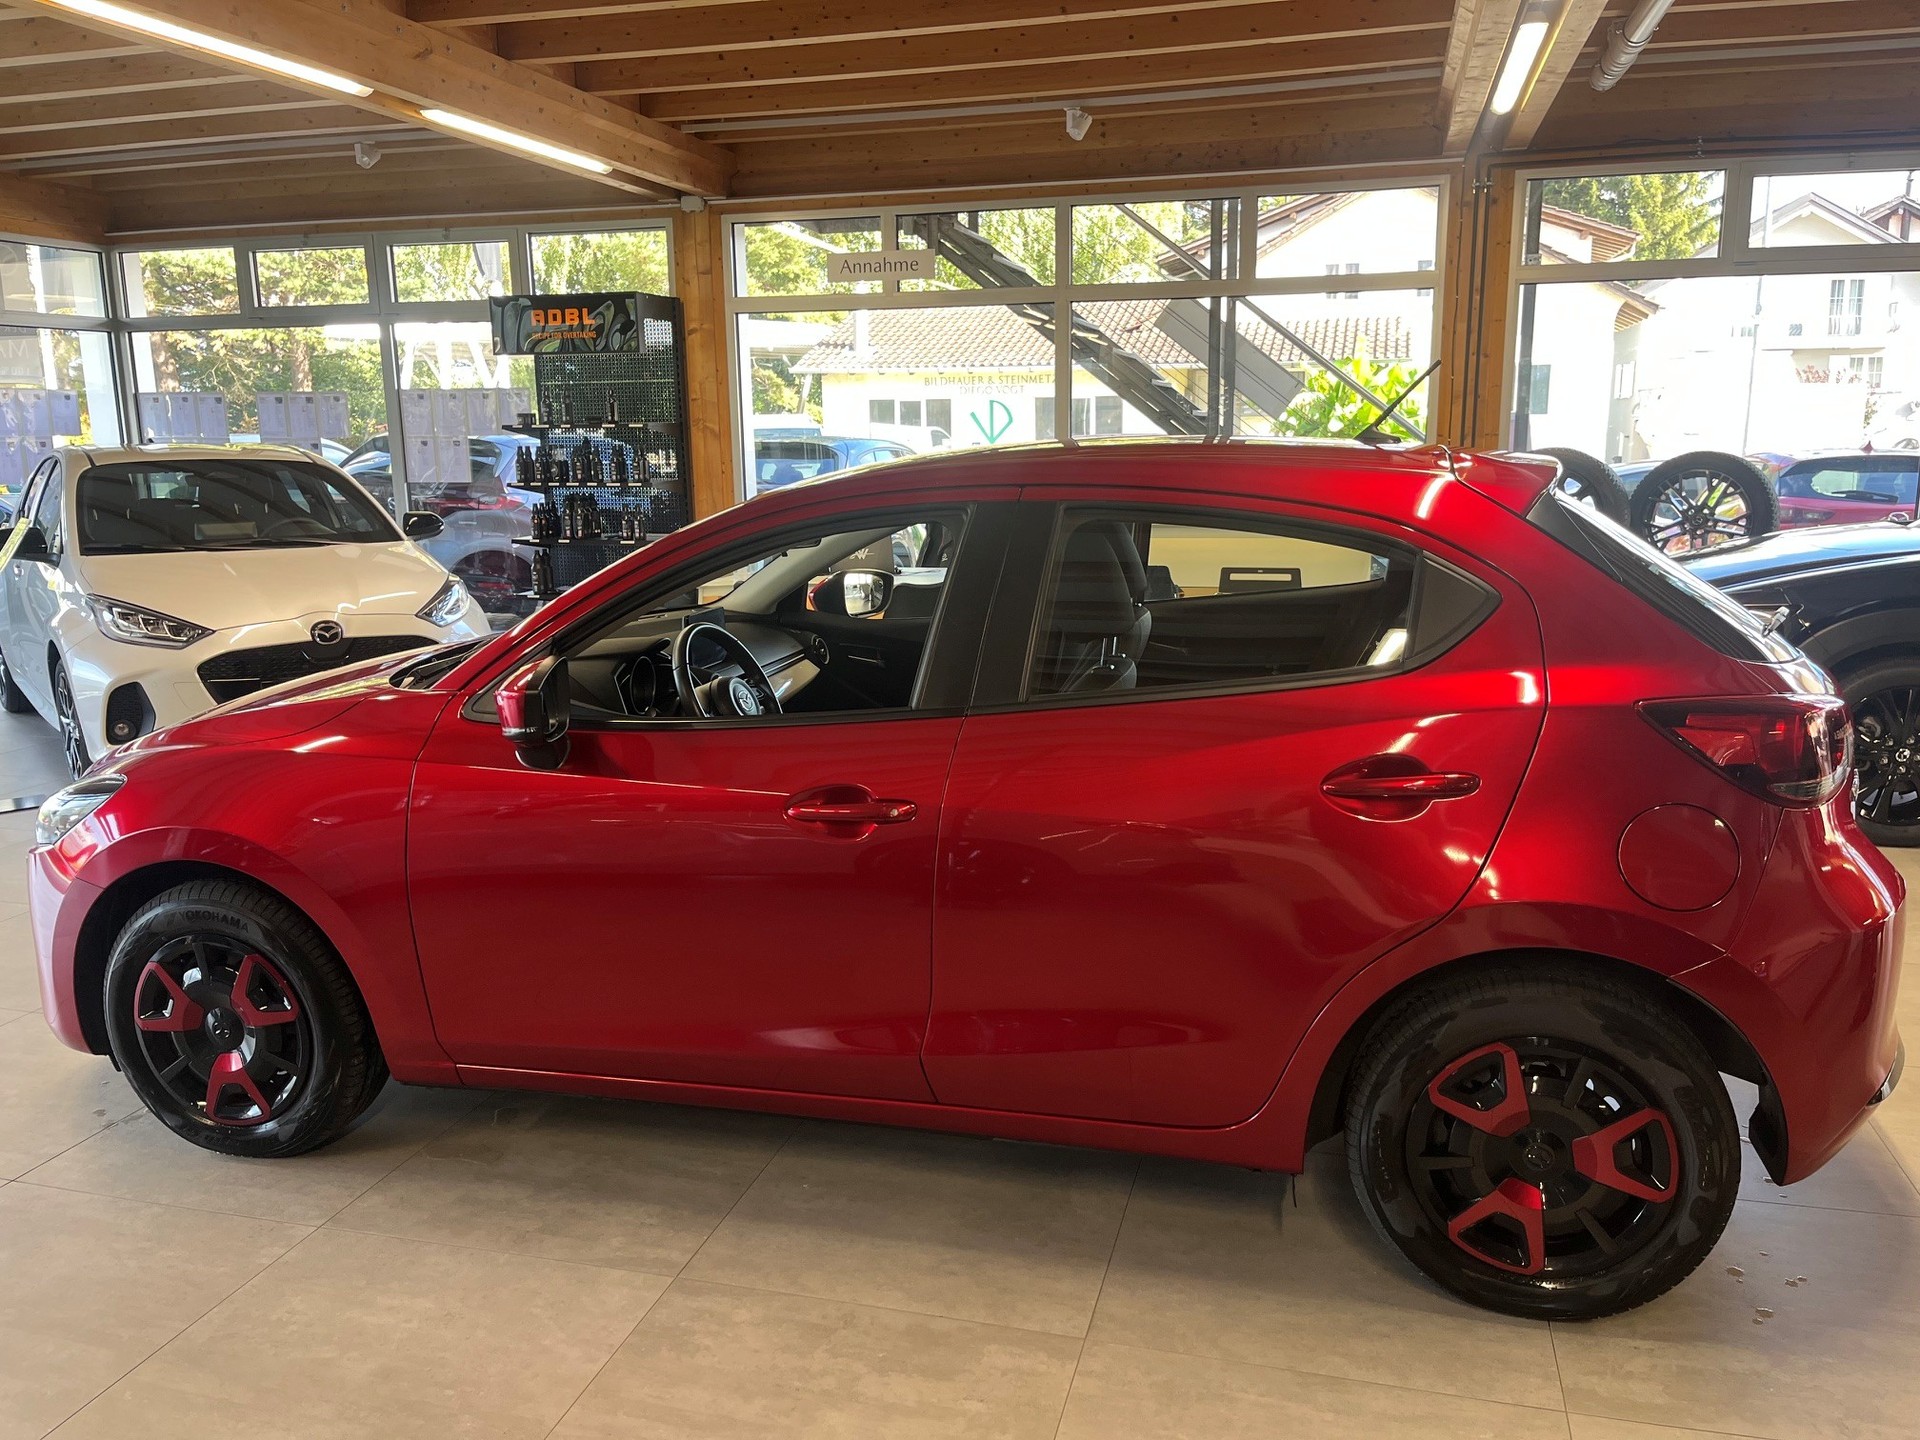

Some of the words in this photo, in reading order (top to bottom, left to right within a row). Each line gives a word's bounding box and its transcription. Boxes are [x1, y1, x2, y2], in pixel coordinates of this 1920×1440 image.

[839, 256, 919, 274] Annahme
[531, 308, 595, 325] ADBL
[987, 376, 995, 385] &
[178, 909, 249, 933] YOKOHAMA
